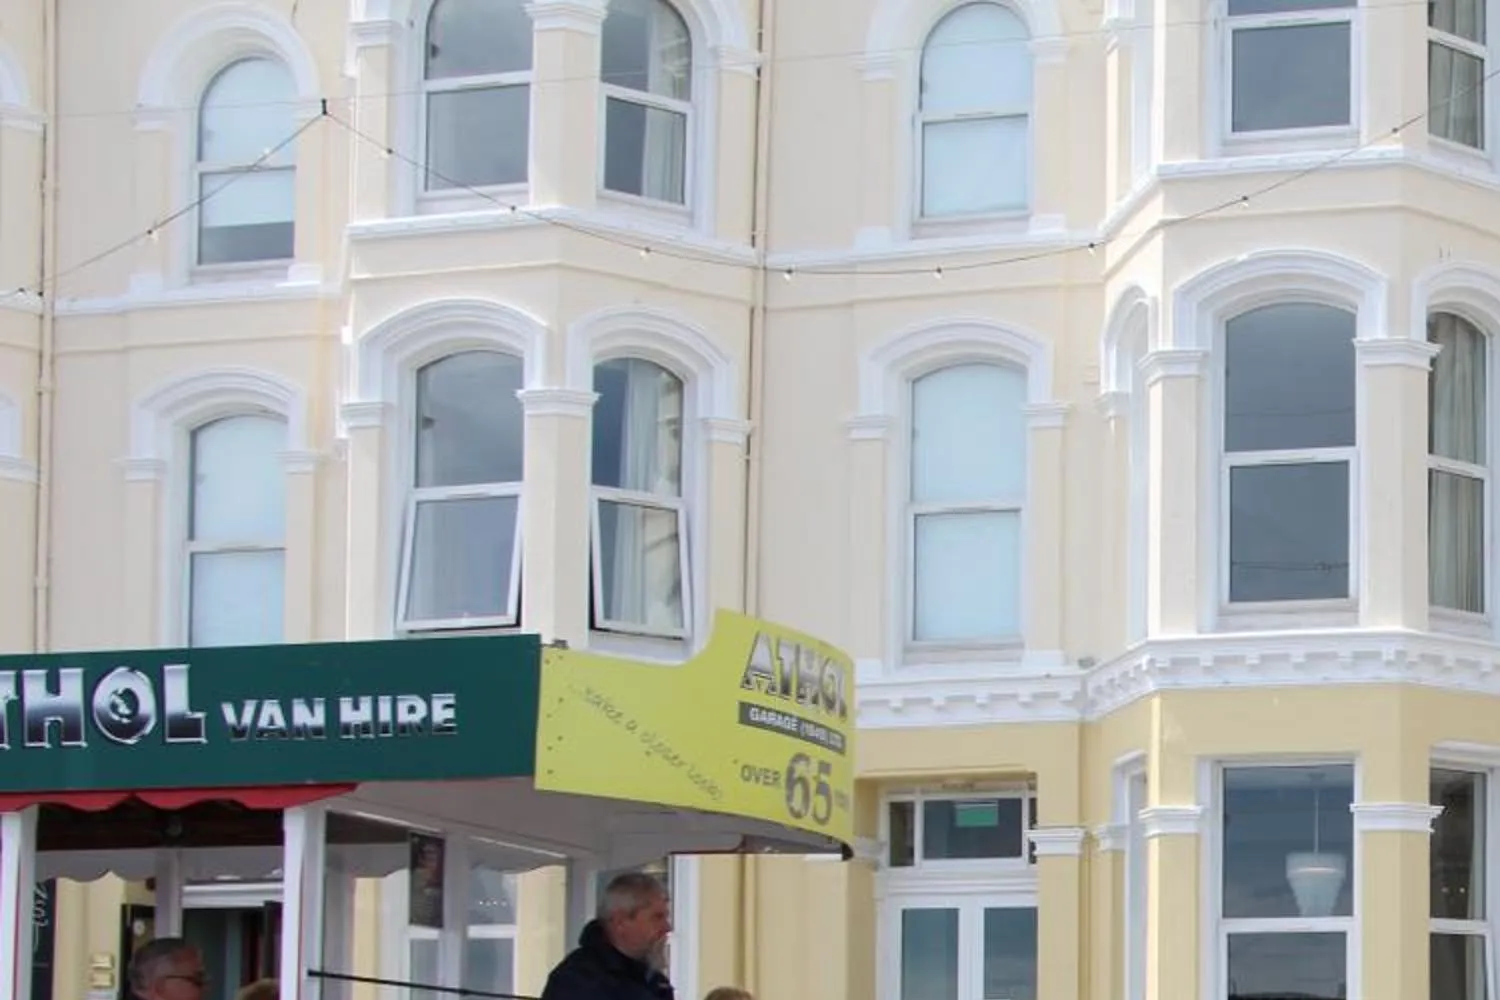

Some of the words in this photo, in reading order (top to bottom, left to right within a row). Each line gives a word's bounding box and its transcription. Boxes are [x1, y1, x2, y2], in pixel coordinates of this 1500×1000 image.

[740, 630, 848, 721] ATHOL
[220, 698, 327, 742] VAN
[339, 693, 458, 739] HIRE
[749, 706, 799, 732] GARAGE
[740, 763, 781, 787] OVER
[785, 751, 832, 825] 65
